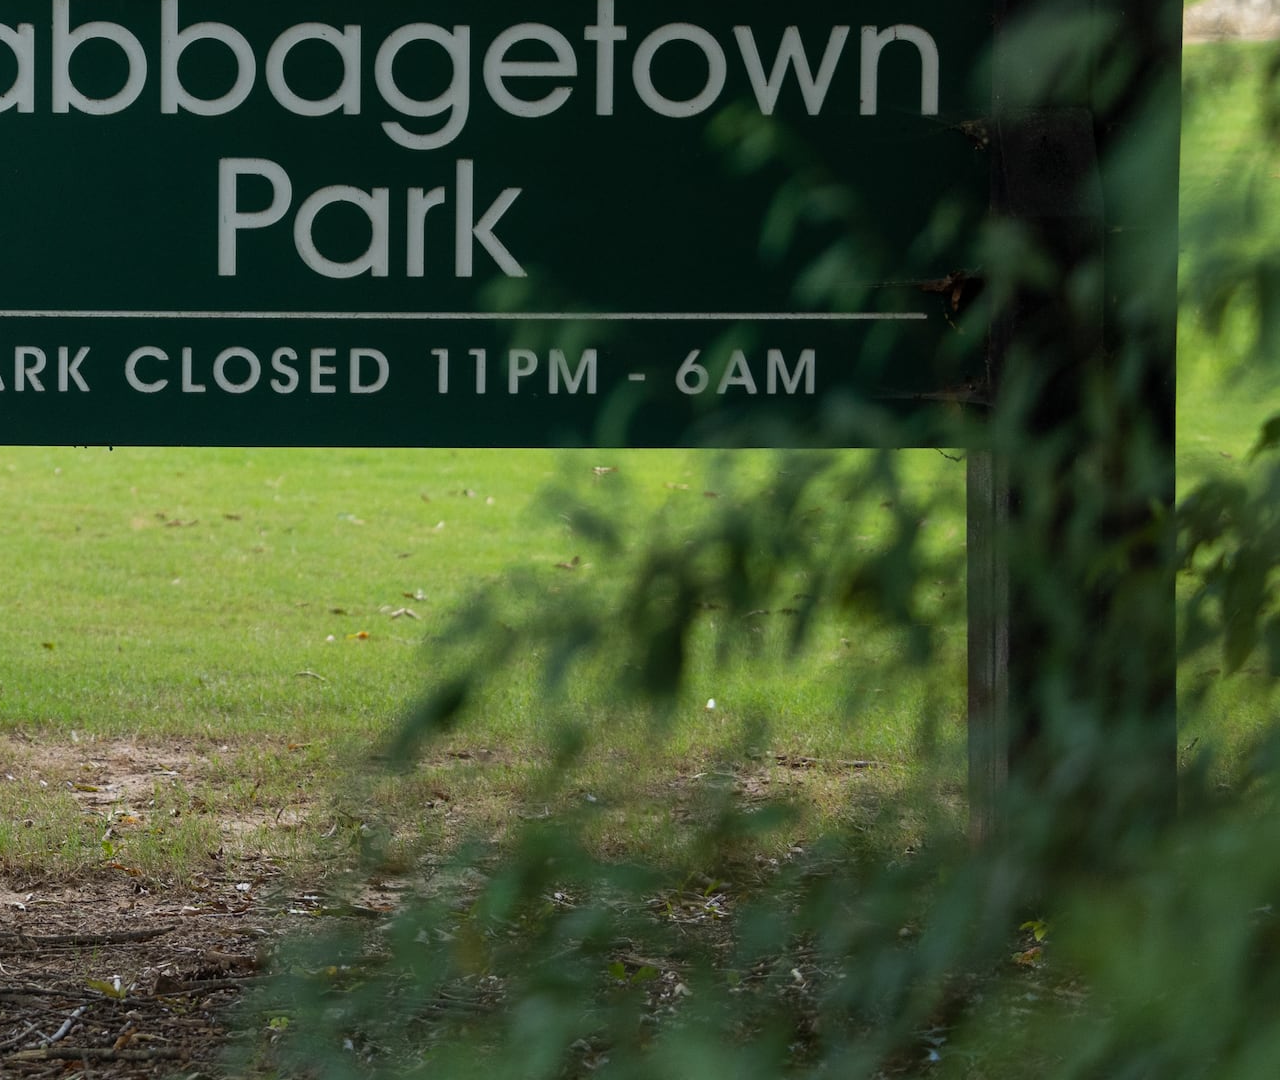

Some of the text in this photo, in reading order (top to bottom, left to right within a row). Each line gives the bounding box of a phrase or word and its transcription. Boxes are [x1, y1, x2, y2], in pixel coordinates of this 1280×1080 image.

[217, 158, 528, 279] Park
[125, 346, 390, 394] CLOSED
[431, 348, 598, 394] 11PM
[674, 349, 817, 395] 6AM
